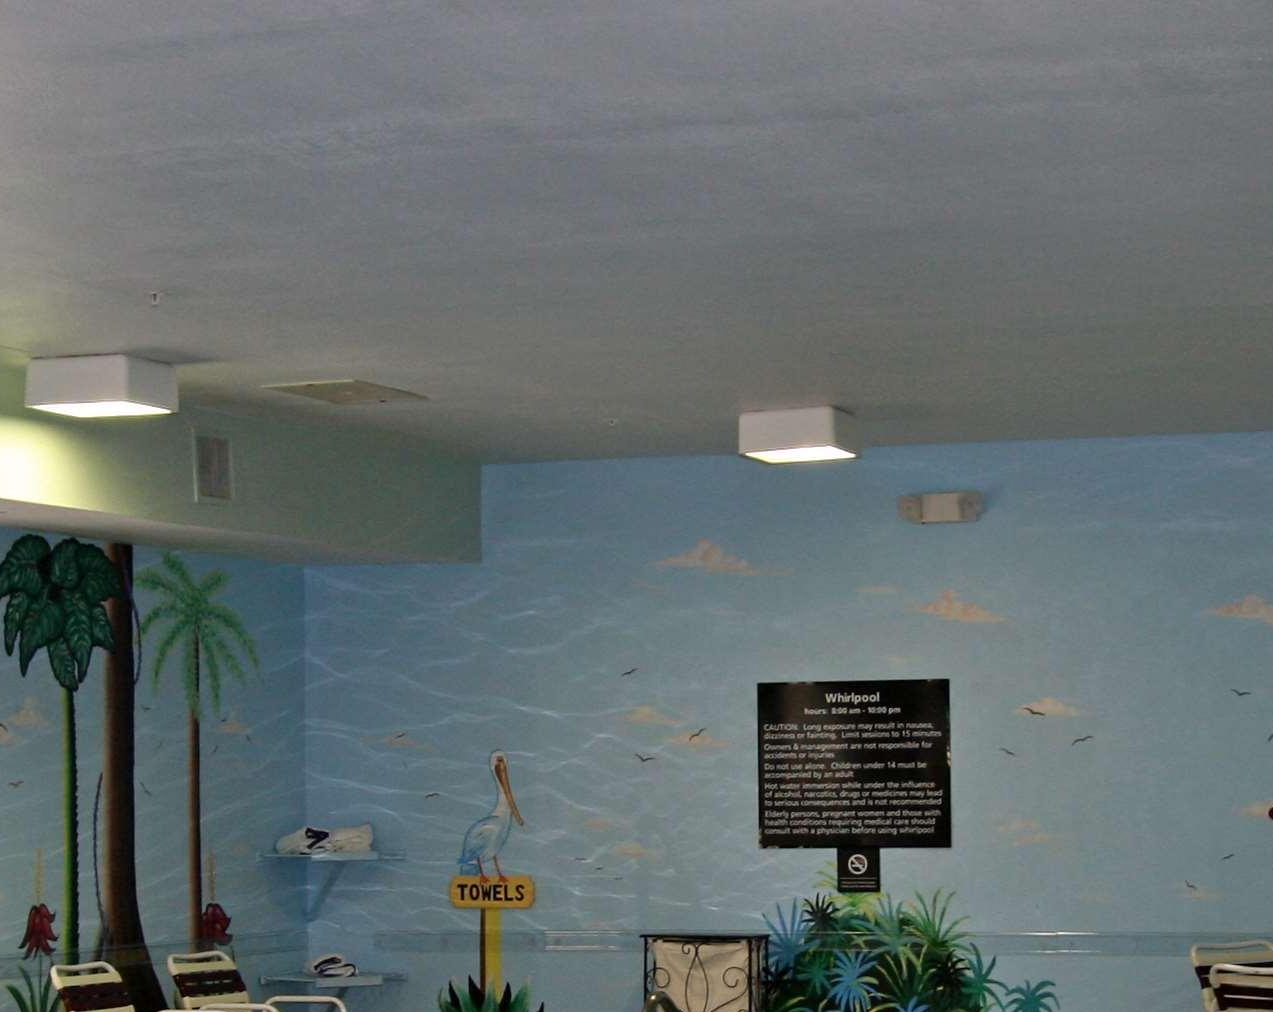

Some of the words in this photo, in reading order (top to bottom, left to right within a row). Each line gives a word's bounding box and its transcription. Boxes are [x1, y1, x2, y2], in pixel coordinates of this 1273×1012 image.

[825, 691, 880, 705] Whirlpool
[888, 707, 901, 715] pm
[457, 883, 525, 902] TOWELS
